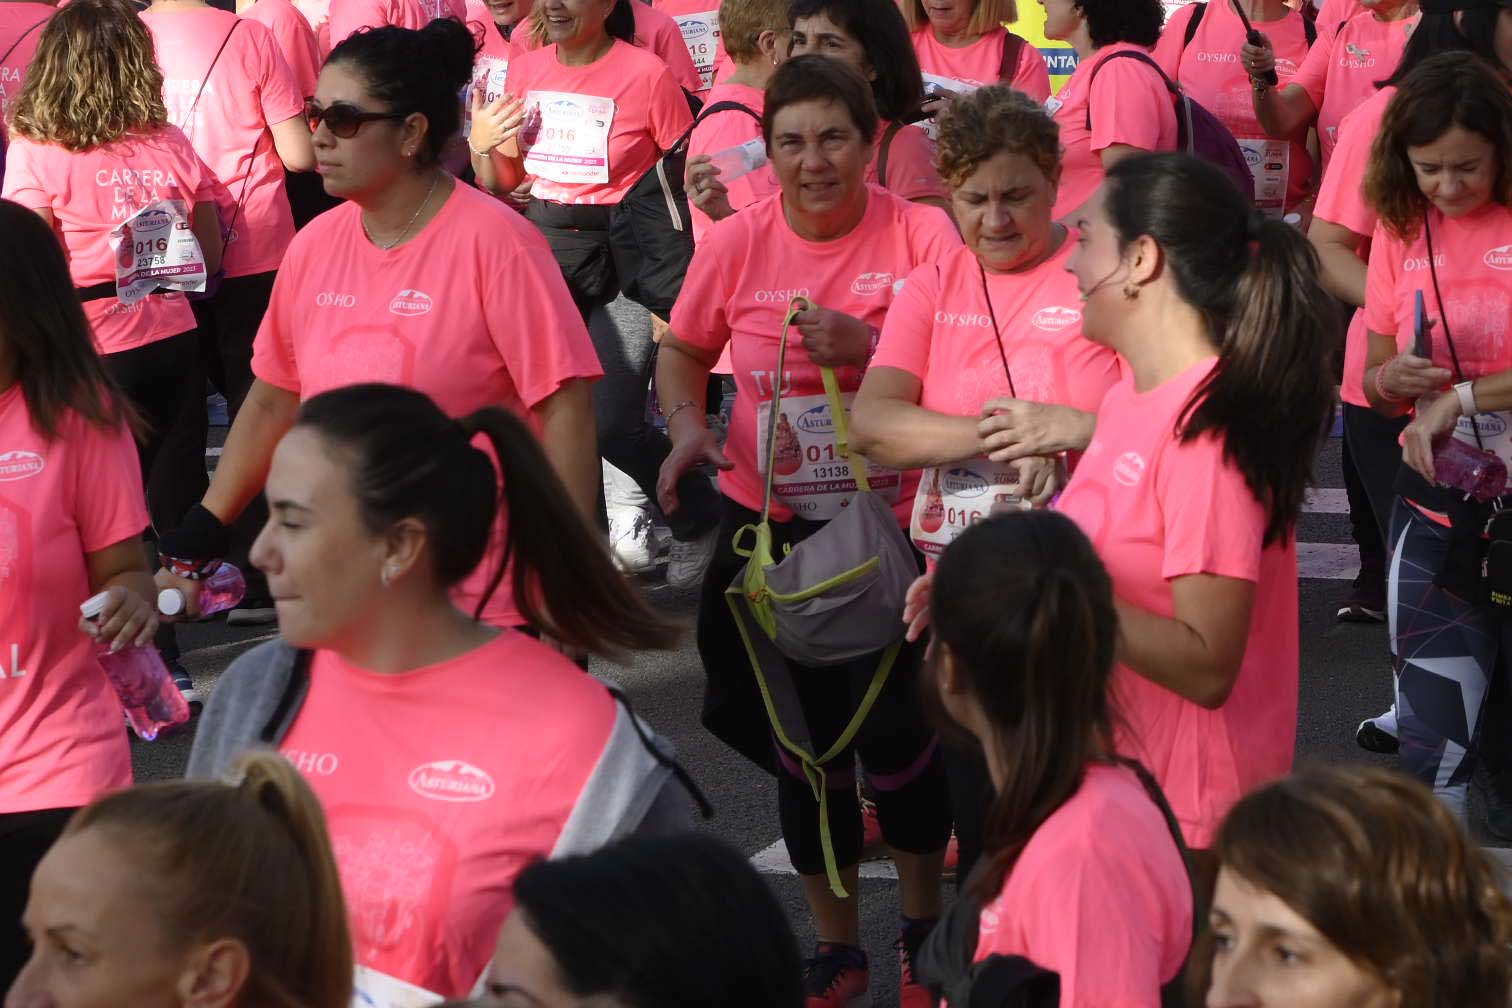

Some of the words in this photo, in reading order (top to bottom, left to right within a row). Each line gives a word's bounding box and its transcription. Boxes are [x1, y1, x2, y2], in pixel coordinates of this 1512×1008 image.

[689, 43, 707, 55] 16
[1197, 52, 1237, 63] OYSHO
[546, 128, 576, 142] 016
[95, 169, 177, 187] CARRERA
[114, 186, 134, 203] DE
[136, 238, 168, 254] 016
[755, 287, 809, 303] OYSHO
[935, 311, 993, 328] OYSHO
[751, 370, 792, 396] TU
[802, 417, 833, 429] ASTUR
[807, 444, 840, 462] 01
[814, 465, 849, 479] 13138
[778, 485, 816, 494] CARRERA
[947, 507, 982, 526] 016
